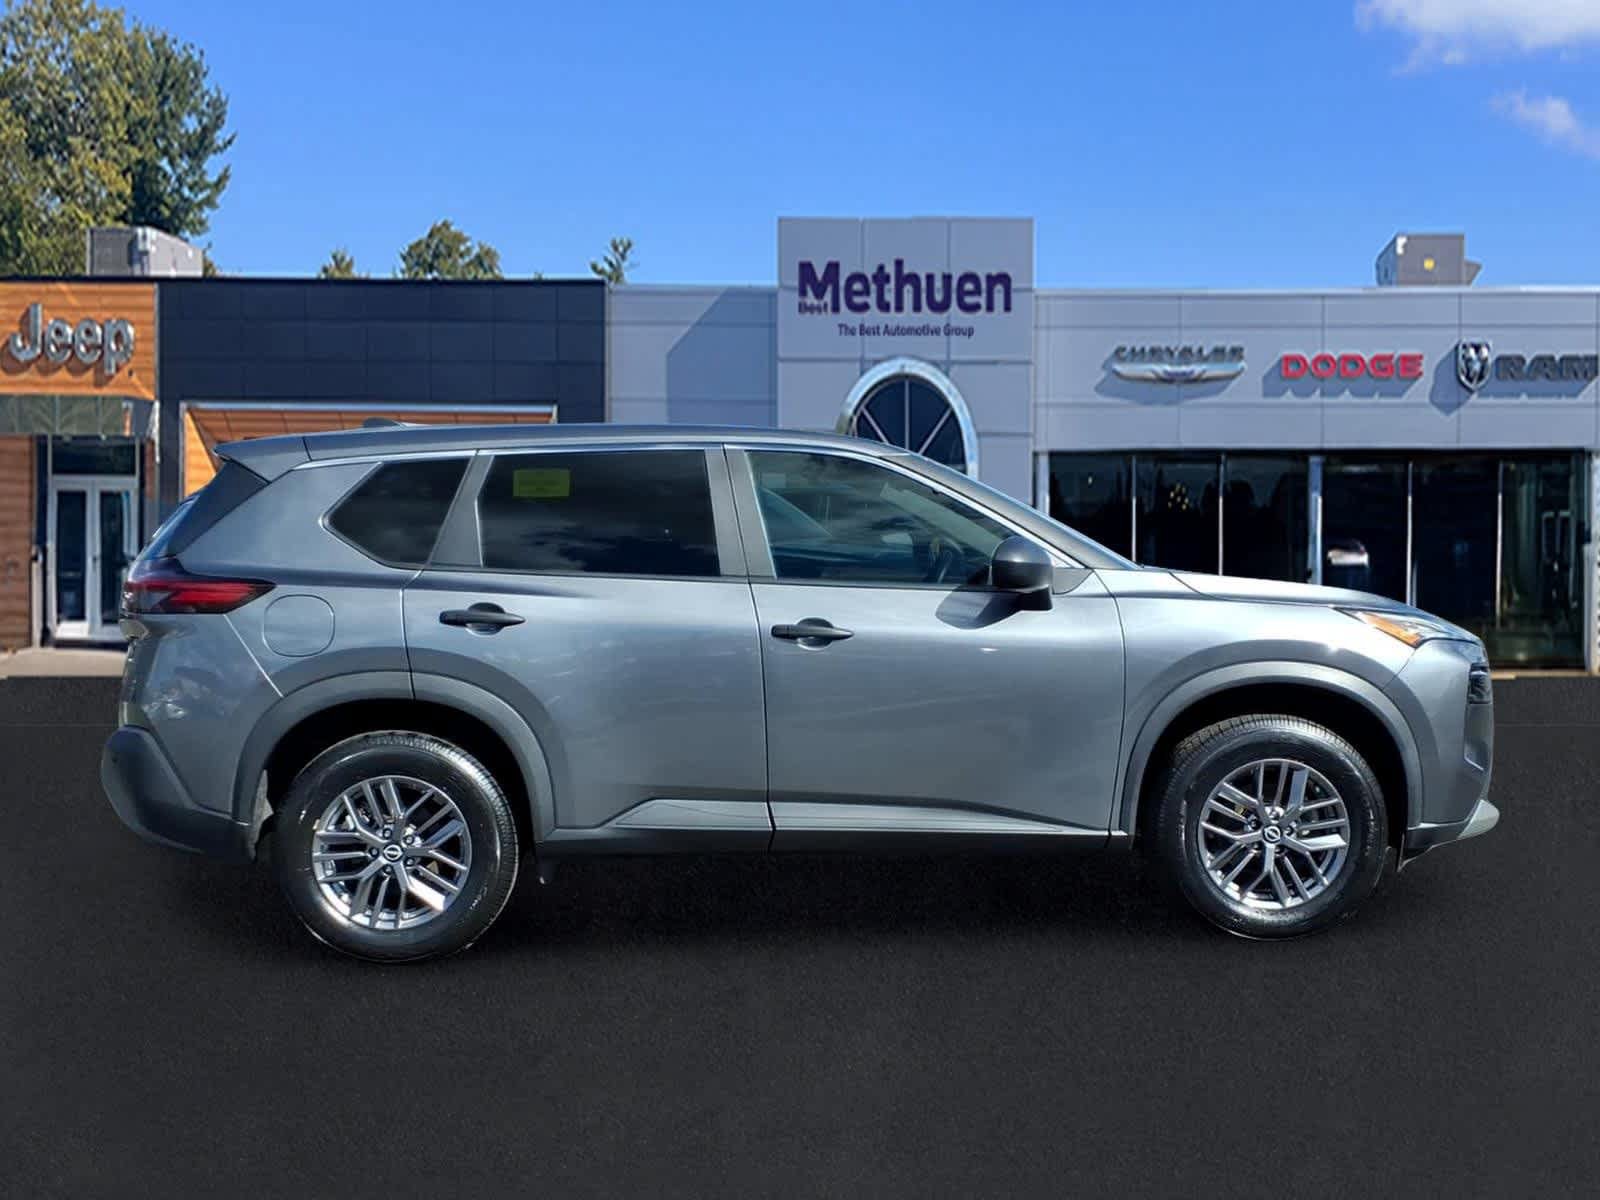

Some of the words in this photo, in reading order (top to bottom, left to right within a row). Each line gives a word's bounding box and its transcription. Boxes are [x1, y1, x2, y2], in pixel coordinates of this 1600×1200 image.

[798, 259, 1012, 314] Methuen
[798, 301, 828, 314] Best
[9, 303, 135, 375] Jeep
[838, 323, 856, 336] The
[859, 323, 880, 336] Best
[883, 323, 941, 336] Automotive
[943, 323, 975, 339] Group
[1114, 345, 1244, 362] CHRYSLER
[1281, 353, 1424, 379] DODGE
[1494, 354, 1598, 381] RAM
